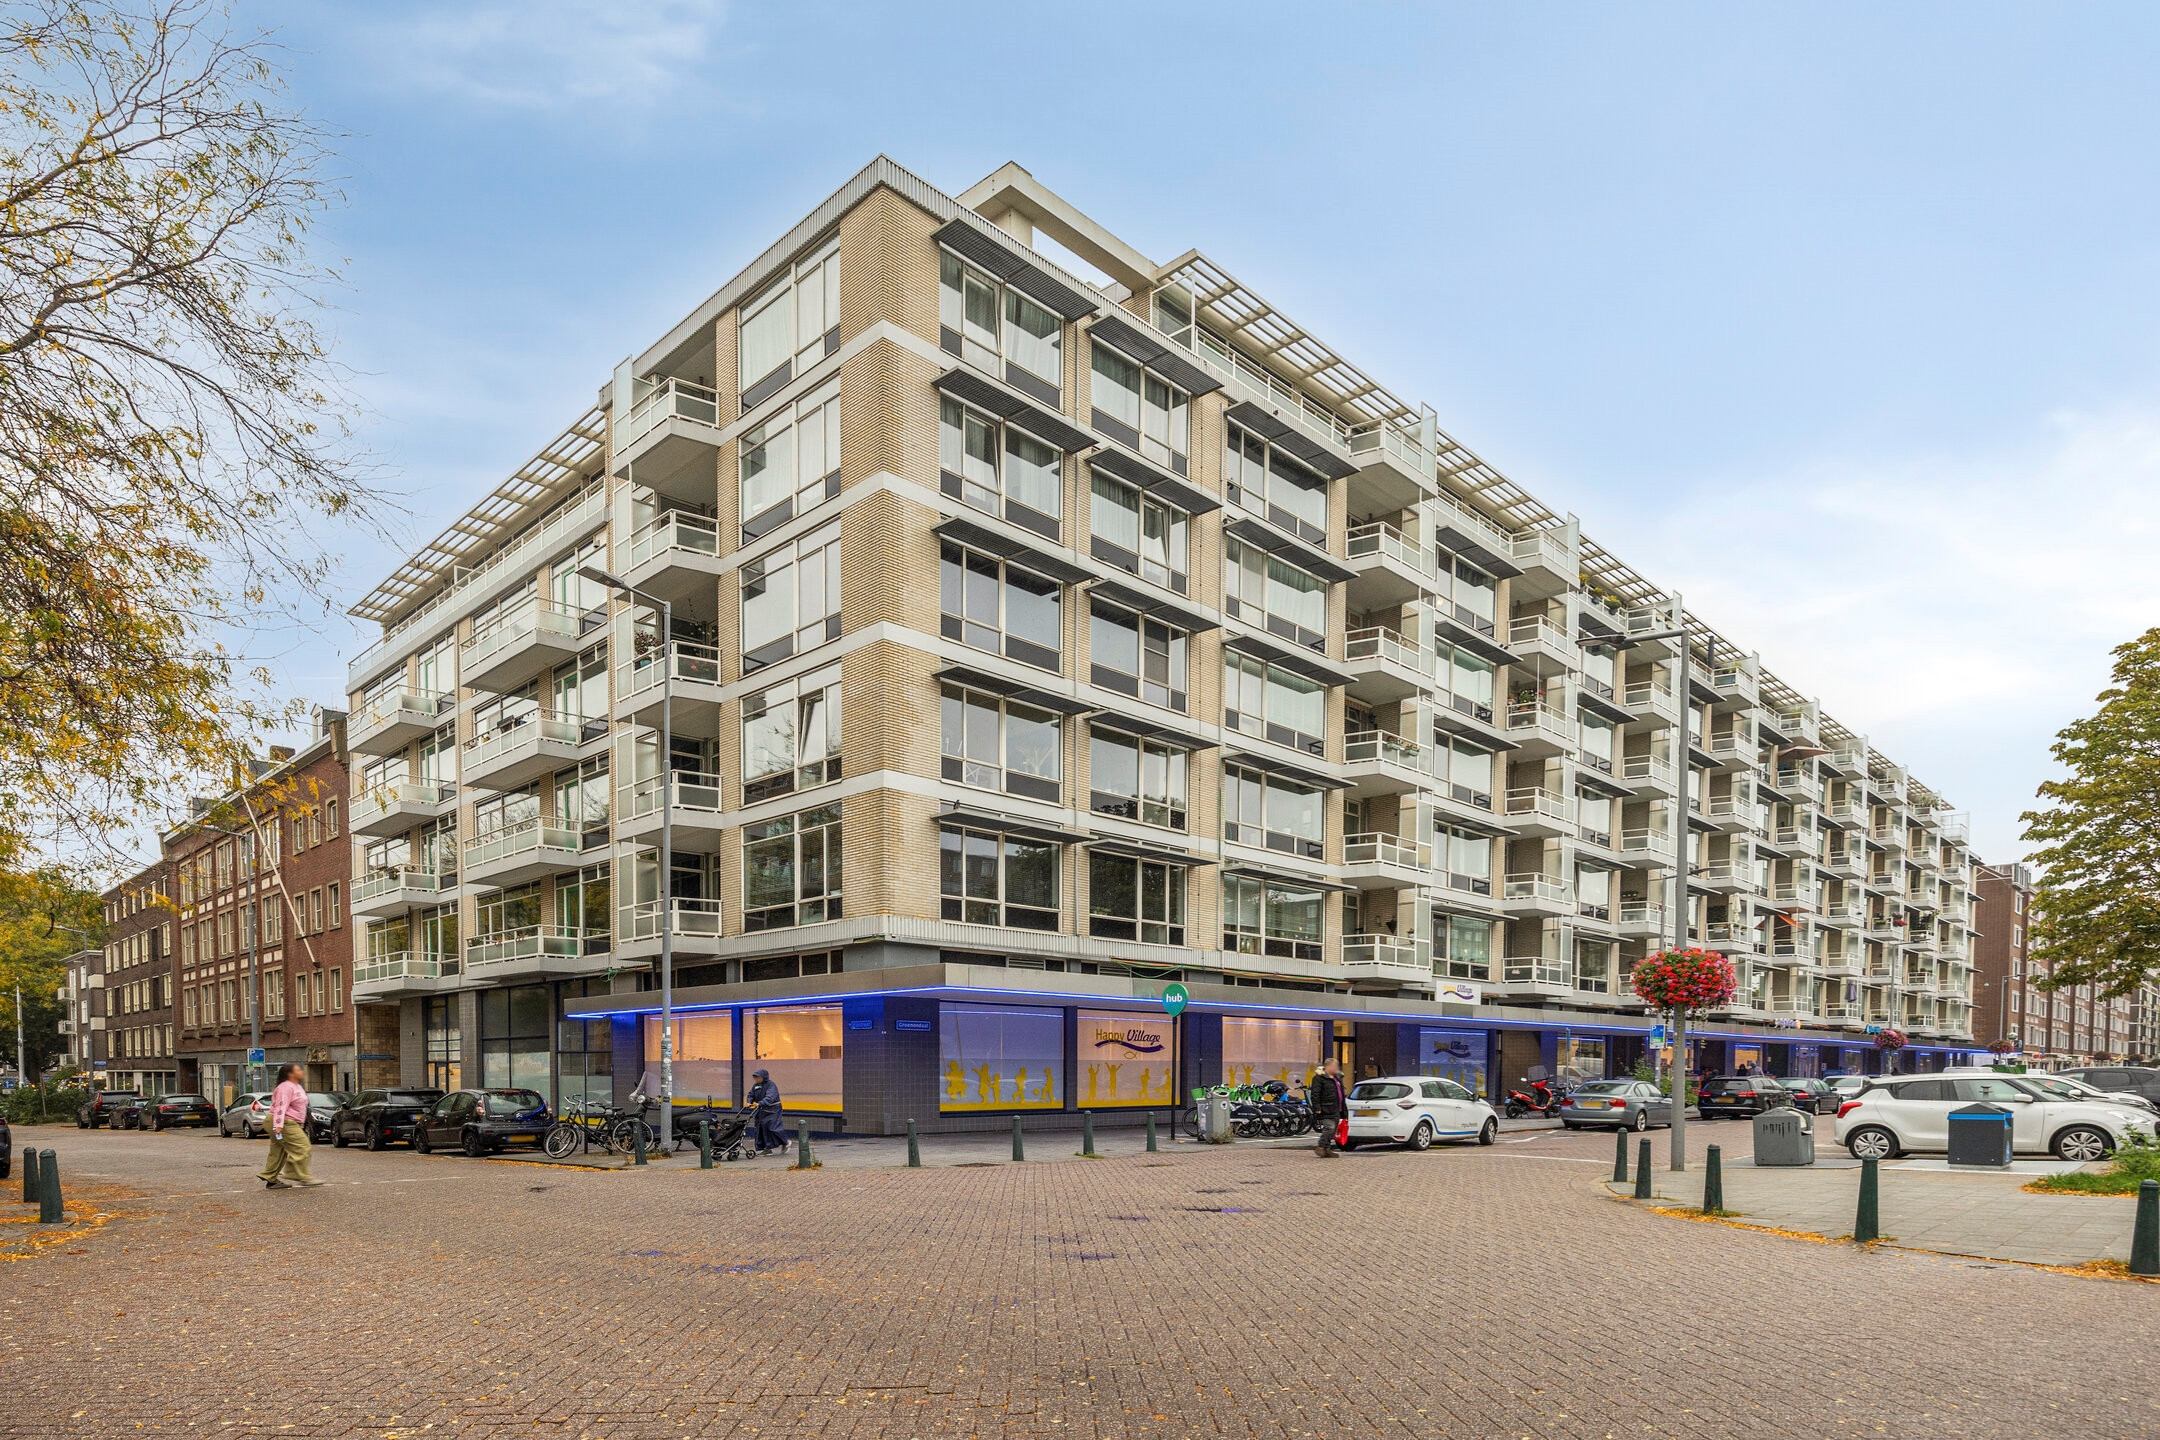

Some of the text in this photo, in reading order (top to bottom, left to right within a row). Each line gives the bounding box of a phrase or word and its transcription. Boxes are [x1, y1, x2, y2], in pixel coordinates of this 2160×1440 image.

[1165, 993, 1183, 1003] hub
[1095, 1028, 1161, 1046] Happy Village
